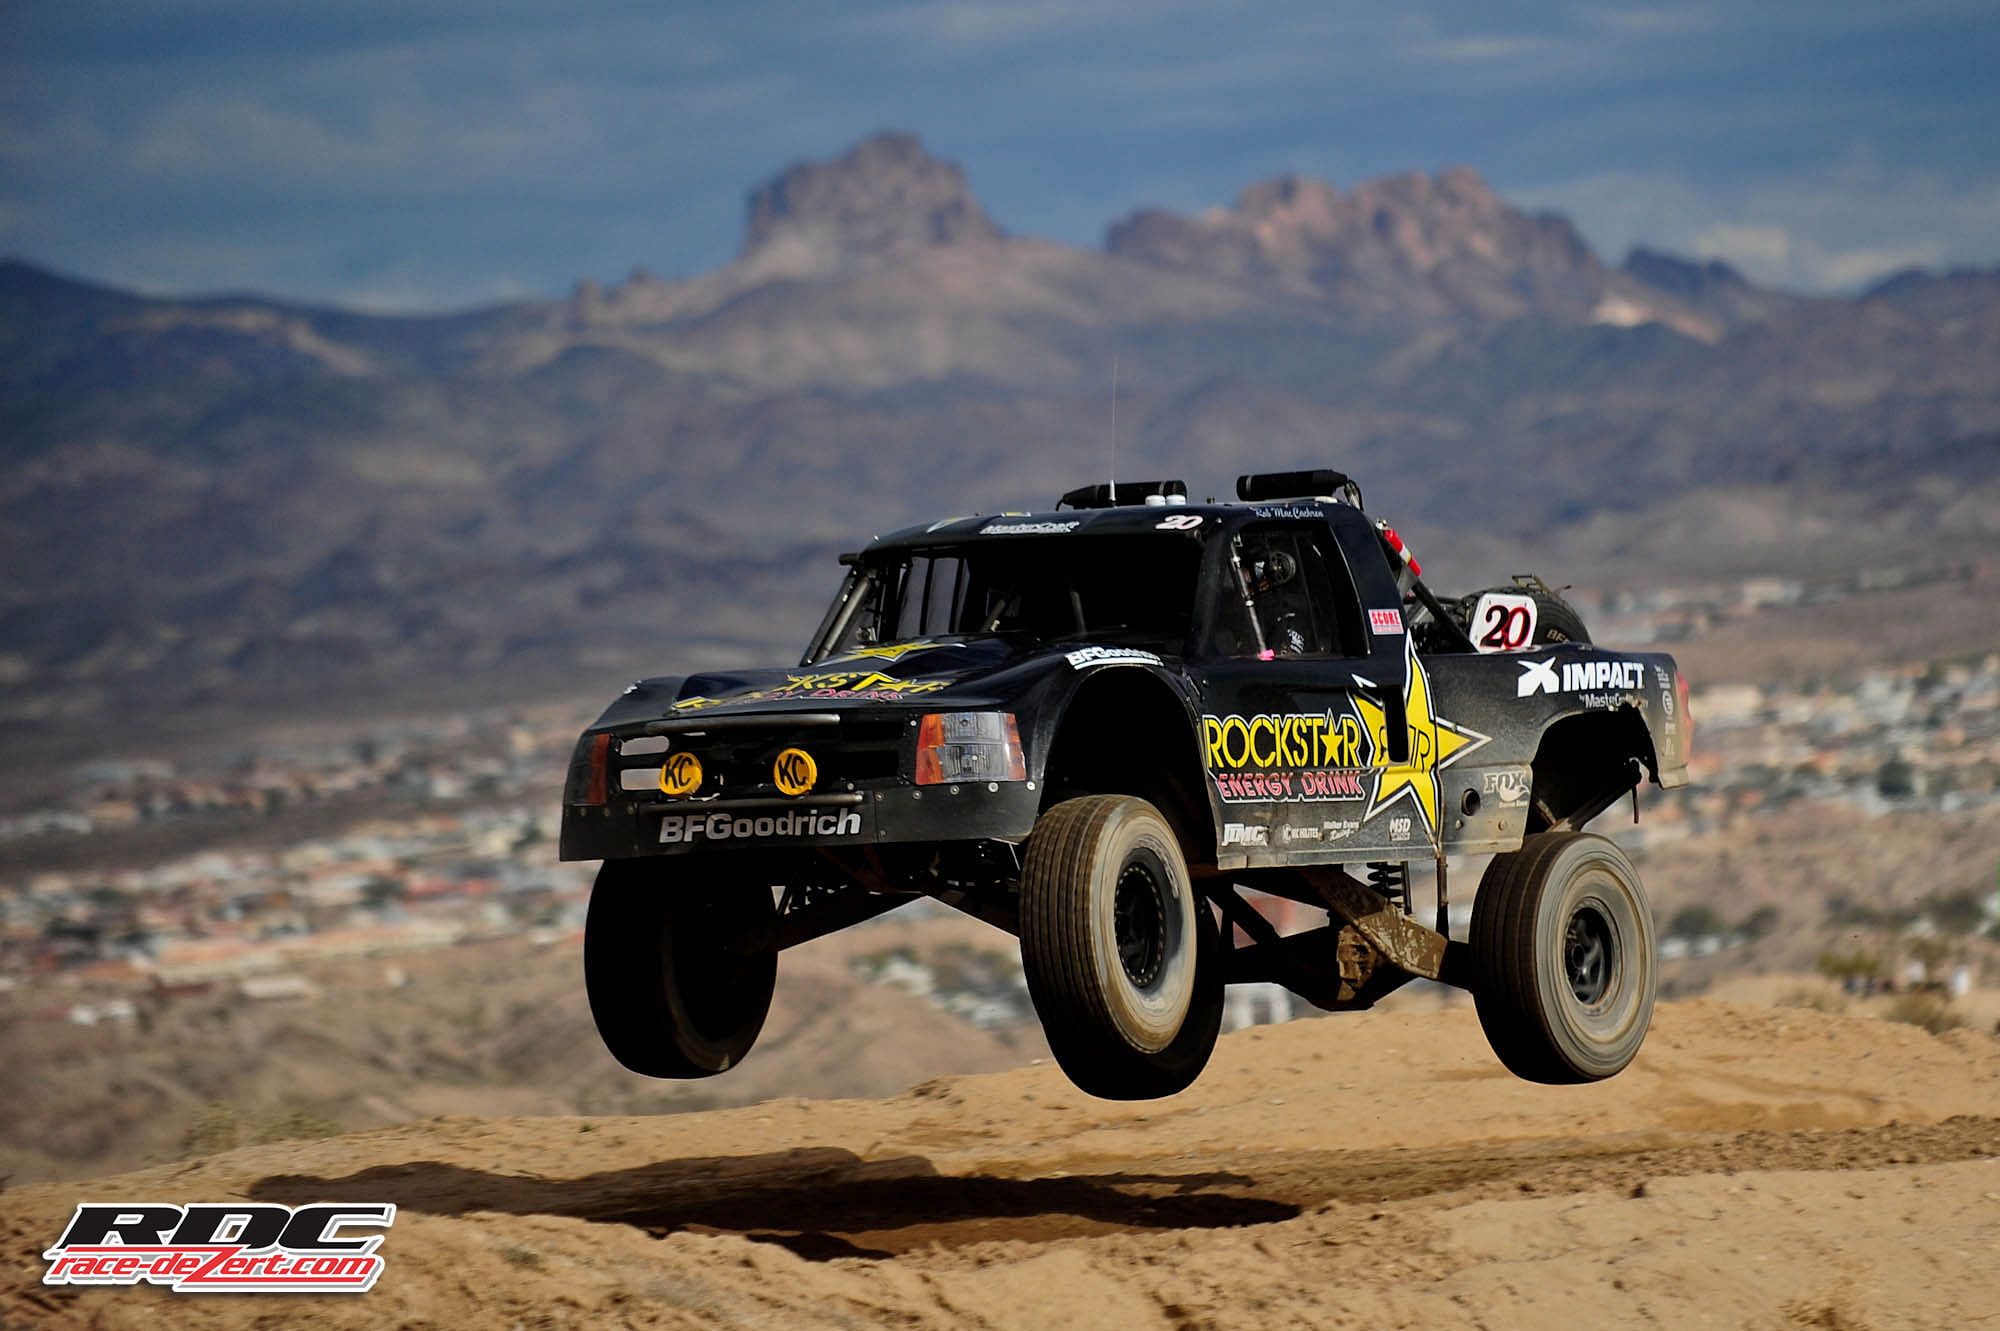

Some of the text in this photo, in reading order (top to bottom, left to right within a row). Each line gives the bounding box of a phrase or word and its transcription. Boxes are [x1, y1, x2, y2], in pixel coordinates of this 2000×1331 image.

[1155, 514, 1203, 530] 20
[1371, 611, 1401, 625] SCORE
[1480, 604, 1532, 649] 20
[1562, 662, 1645, 692] IMPACT
[664, 757, 693, 788] KC
[777, 754, 808, 787] KC
[1217, 770, 1361, 798] ENERGY DRINK
[1483, 770, 1525, 793] FOX
[659, 808, 861, 844] BFGoodrich
[1389, 818, 1411, 833] MSD
